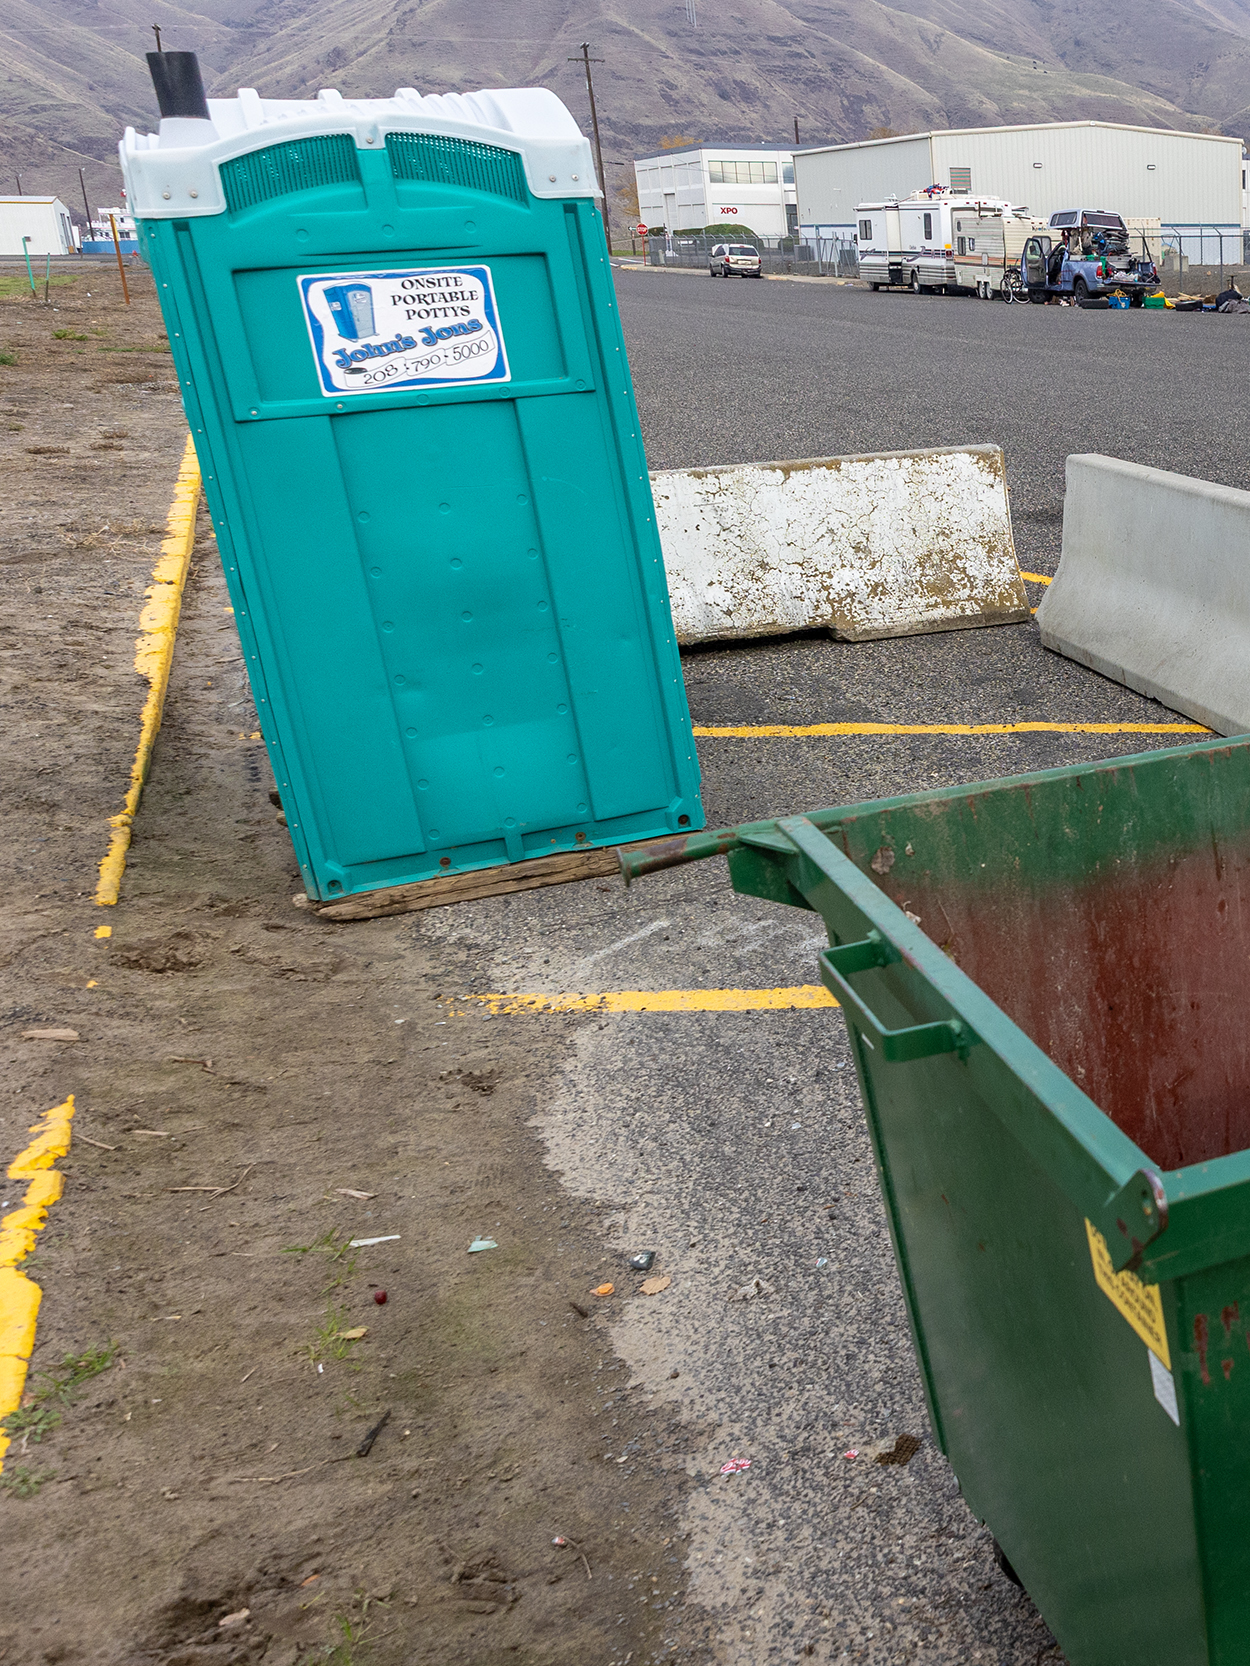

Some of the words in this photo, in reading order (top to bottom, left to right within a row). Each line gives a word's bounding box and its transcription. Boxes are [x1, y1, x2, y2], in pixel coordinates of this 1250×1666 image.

[401, 276, 463, 290] ONSITE
[391, 290, 479, 307] PORTABLE
[405, 305, 471, 321] POTTYS
[331, 333, 417, 369] John's
[418, 318, 483, 347] Jons
